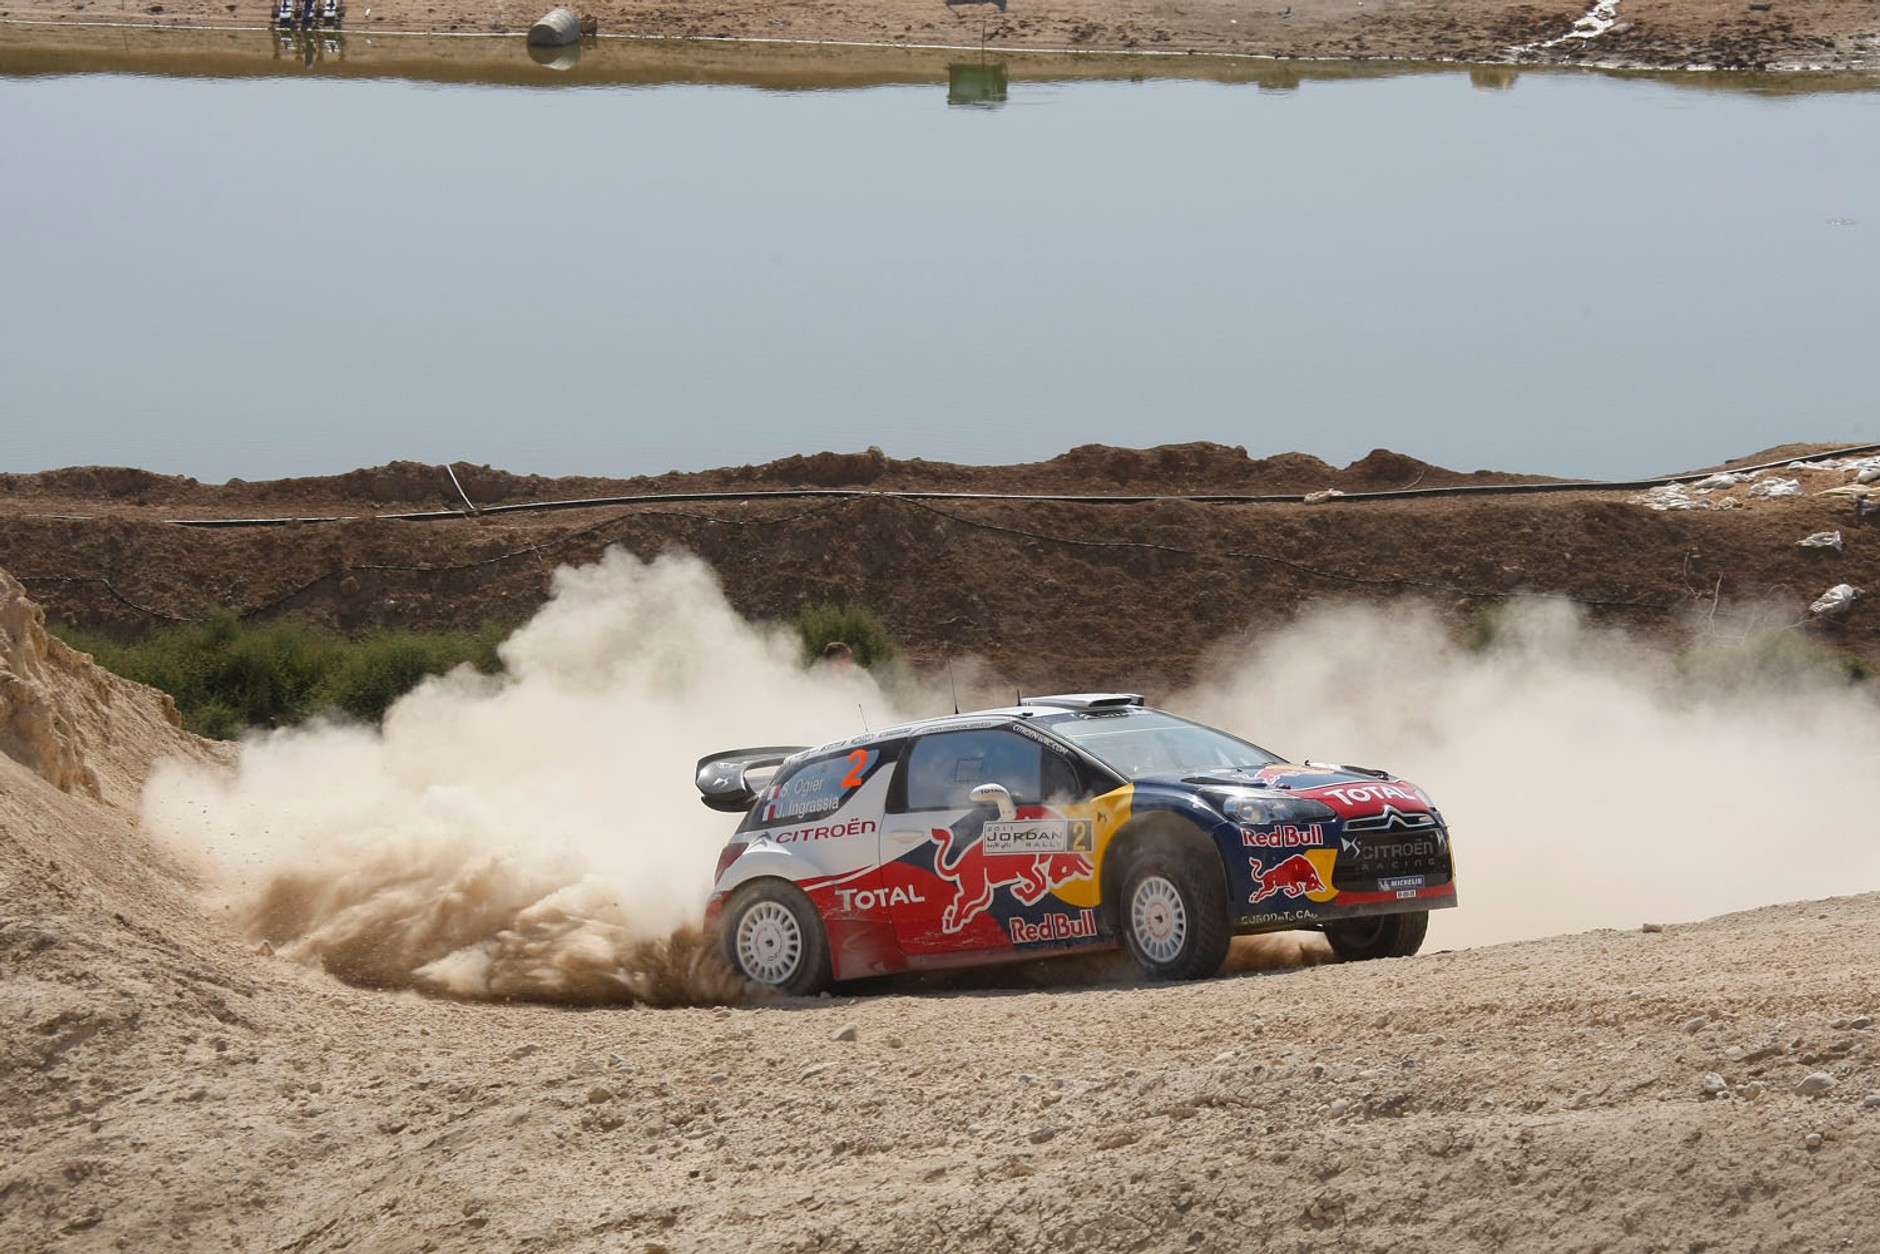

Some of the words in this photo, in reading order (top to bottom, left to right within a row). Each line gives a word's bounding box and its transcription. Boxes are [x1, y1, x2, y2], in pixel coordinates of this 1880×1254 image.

[841, 748, 868, 788] 2
[794, 776, 824, 797] Ogier
[1324, 786, 1417, 806] TOTAL
[789, 794, 840, 819] Ingrassia
[986, 831, 1063, 843] JORDAN
[1073, 822, 1088, 851] 2
[1240, 825, 1282, 847] Red
[1282, 824, 1323, 847] Bull
[1390, 877, 1423, 887] MICHELIN
[834, 884, 925, 912] TOTAL
[1009, 913, 1055, 944] Red
[1053, 909, 1098, 940] Bull
